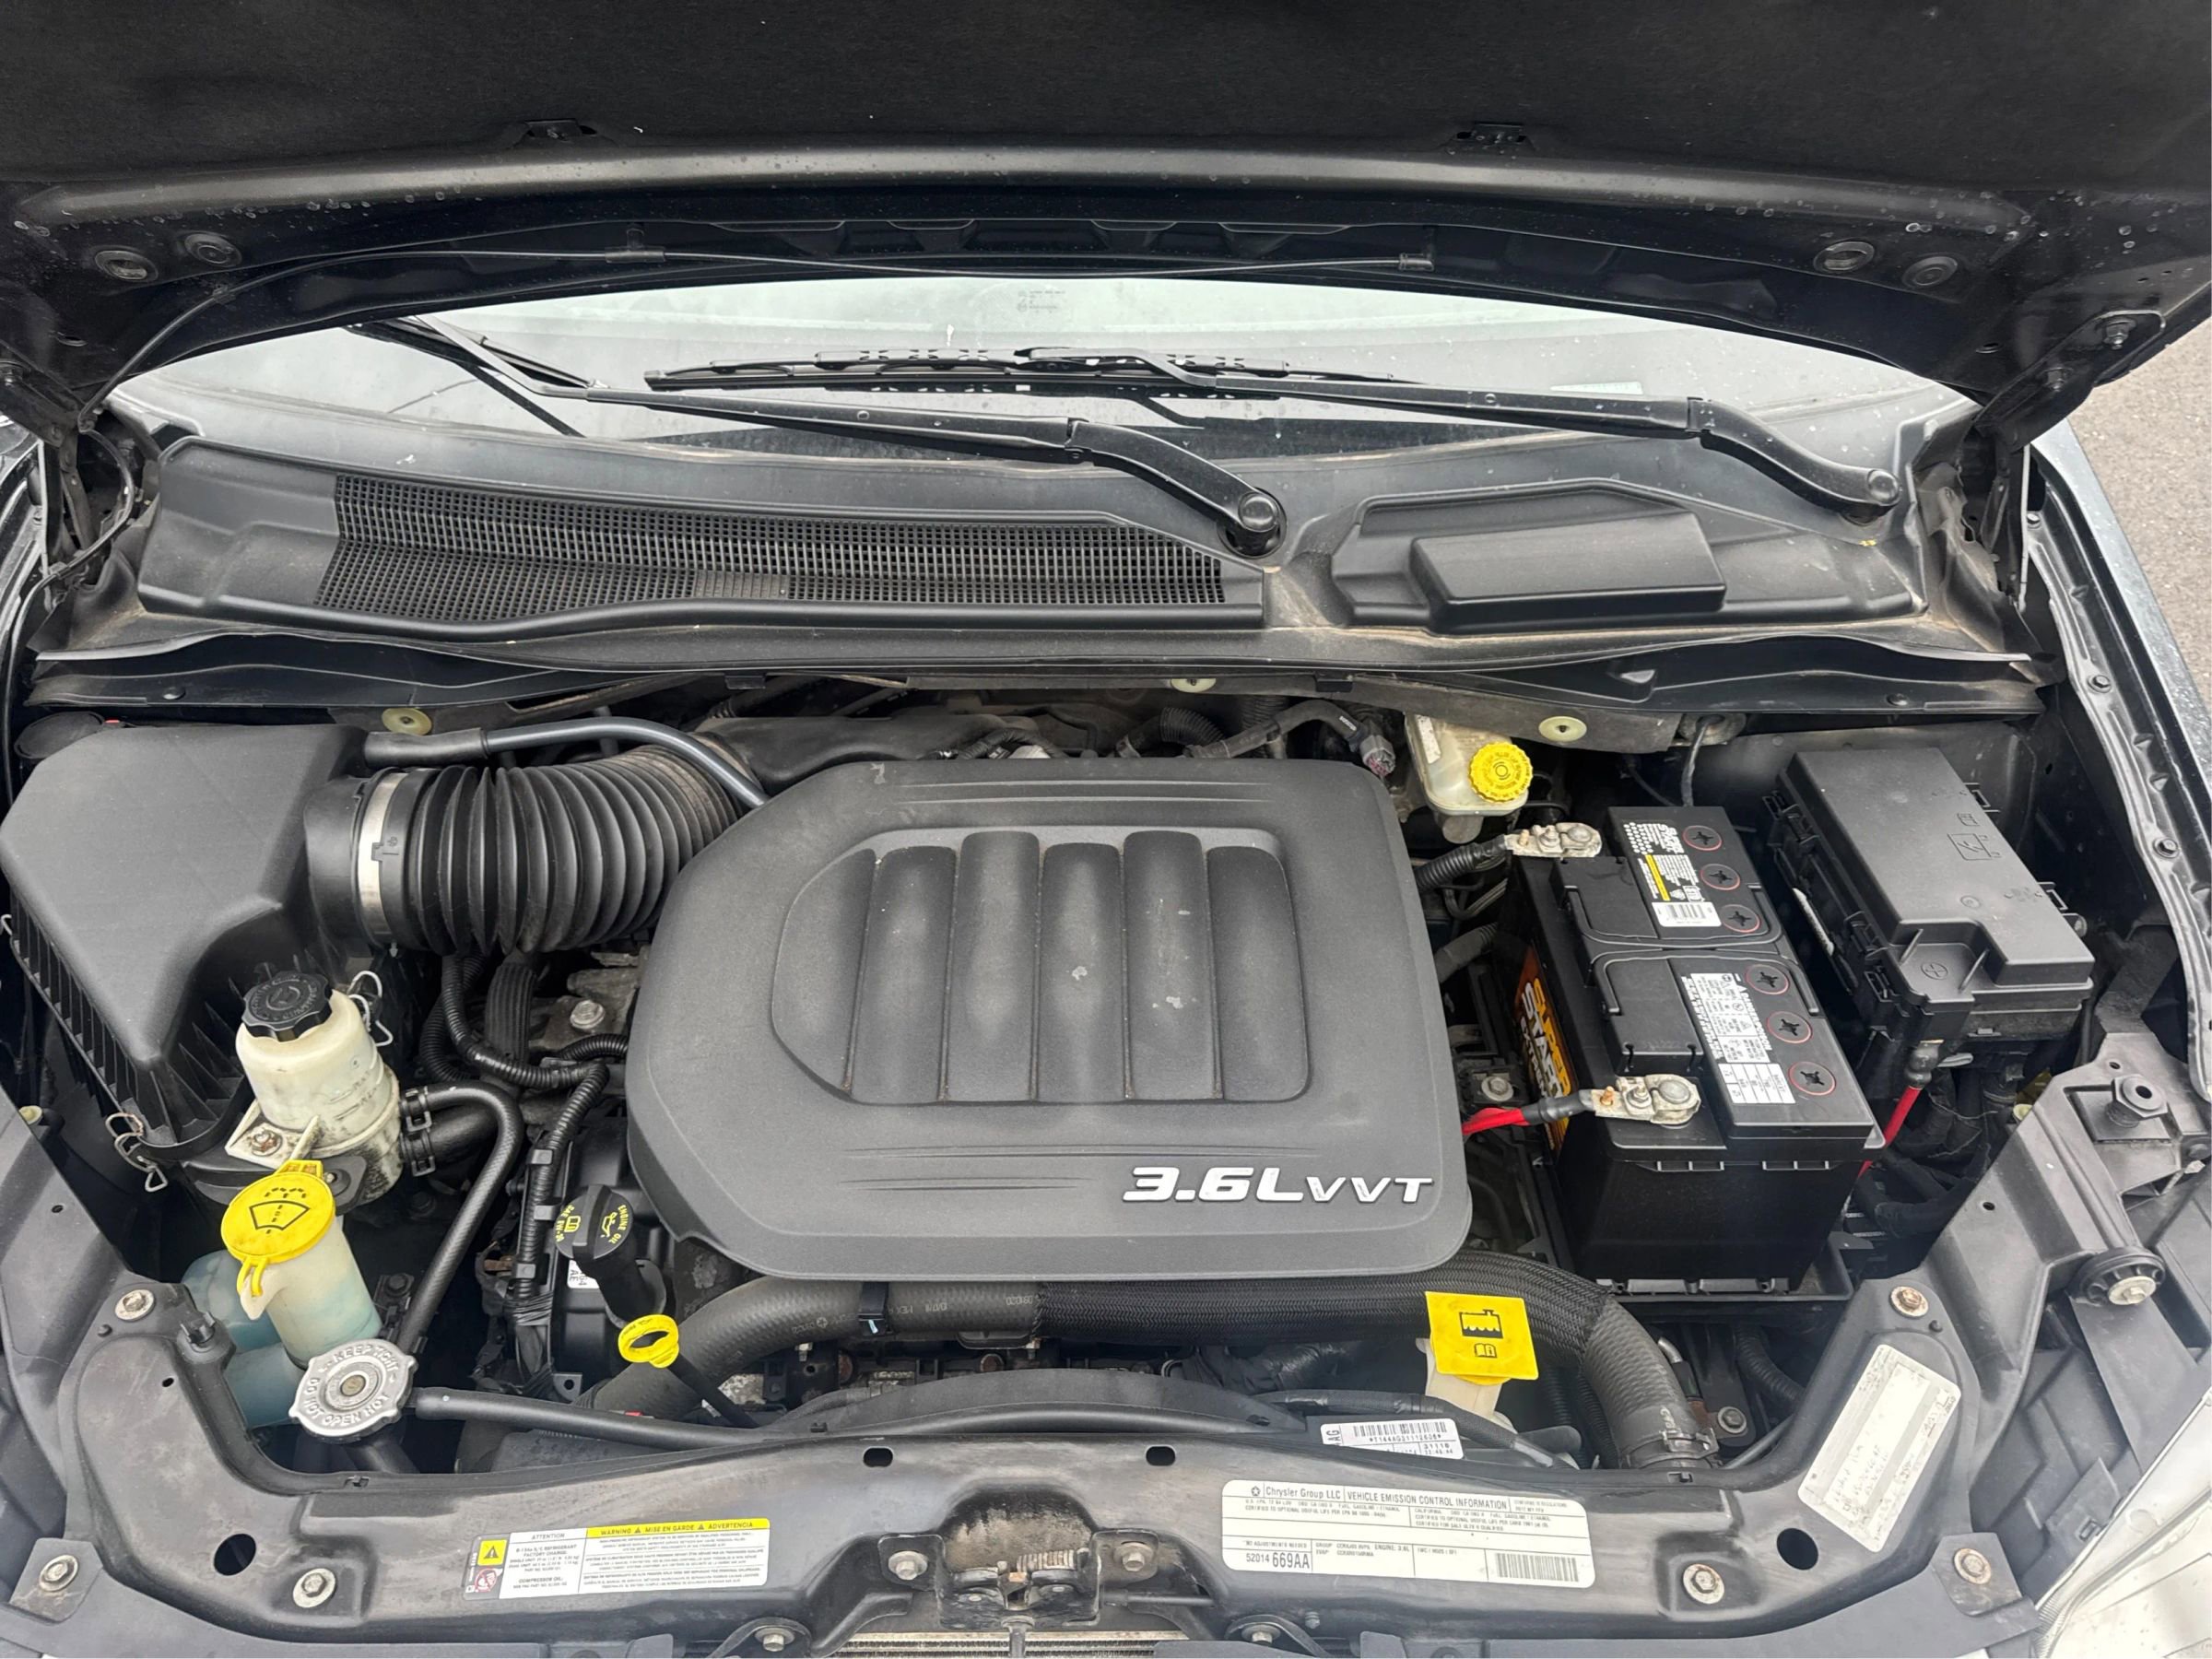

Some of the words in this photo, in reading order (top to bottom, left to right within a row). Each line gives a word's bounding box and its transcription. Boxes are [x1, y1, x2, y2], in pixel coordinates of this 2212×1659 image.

[1522, 982, 1564, 1098] START
[1534, 978, 1571, 1096] SUPER
[1123, 1167, 1303, 1203] 3.6L
[1306, 1177, 1433, 1203] VVT
[618, 1205, 629, 1230] ENGINE
[608, 1233, 622, 1244] OIL
[332, 1345, 372, 1363] KEEP
[373, 1347, 398, 1371] TIGHT
[304, 1378, 320, 1394] DO
[304, 1396, 325, 1419] NOT
[363, 1392, 390, 1417] HOT
[321, 1412, 362, 1428] OPEN
[1265, 1486, 1298, 1497] Chrysler
[1300, 1488, 1324, 1499] Group
[1326, 1489, 1341, 1500] LLC
[1347, 1491, 1379, 1501] VEHICLE
[1381, 1493, 1417, 1503] EMISSION
[1418, 1495, 1453, 1506] CONTROL
[1455, 1498, 1507, 1510] INFORMATION
[708, 1522, 753, 1530] ADVERTENCIA
[1246, 1553, 1270, 1562] 52014
[1273, 1552, 1310, 1569] 669AA
